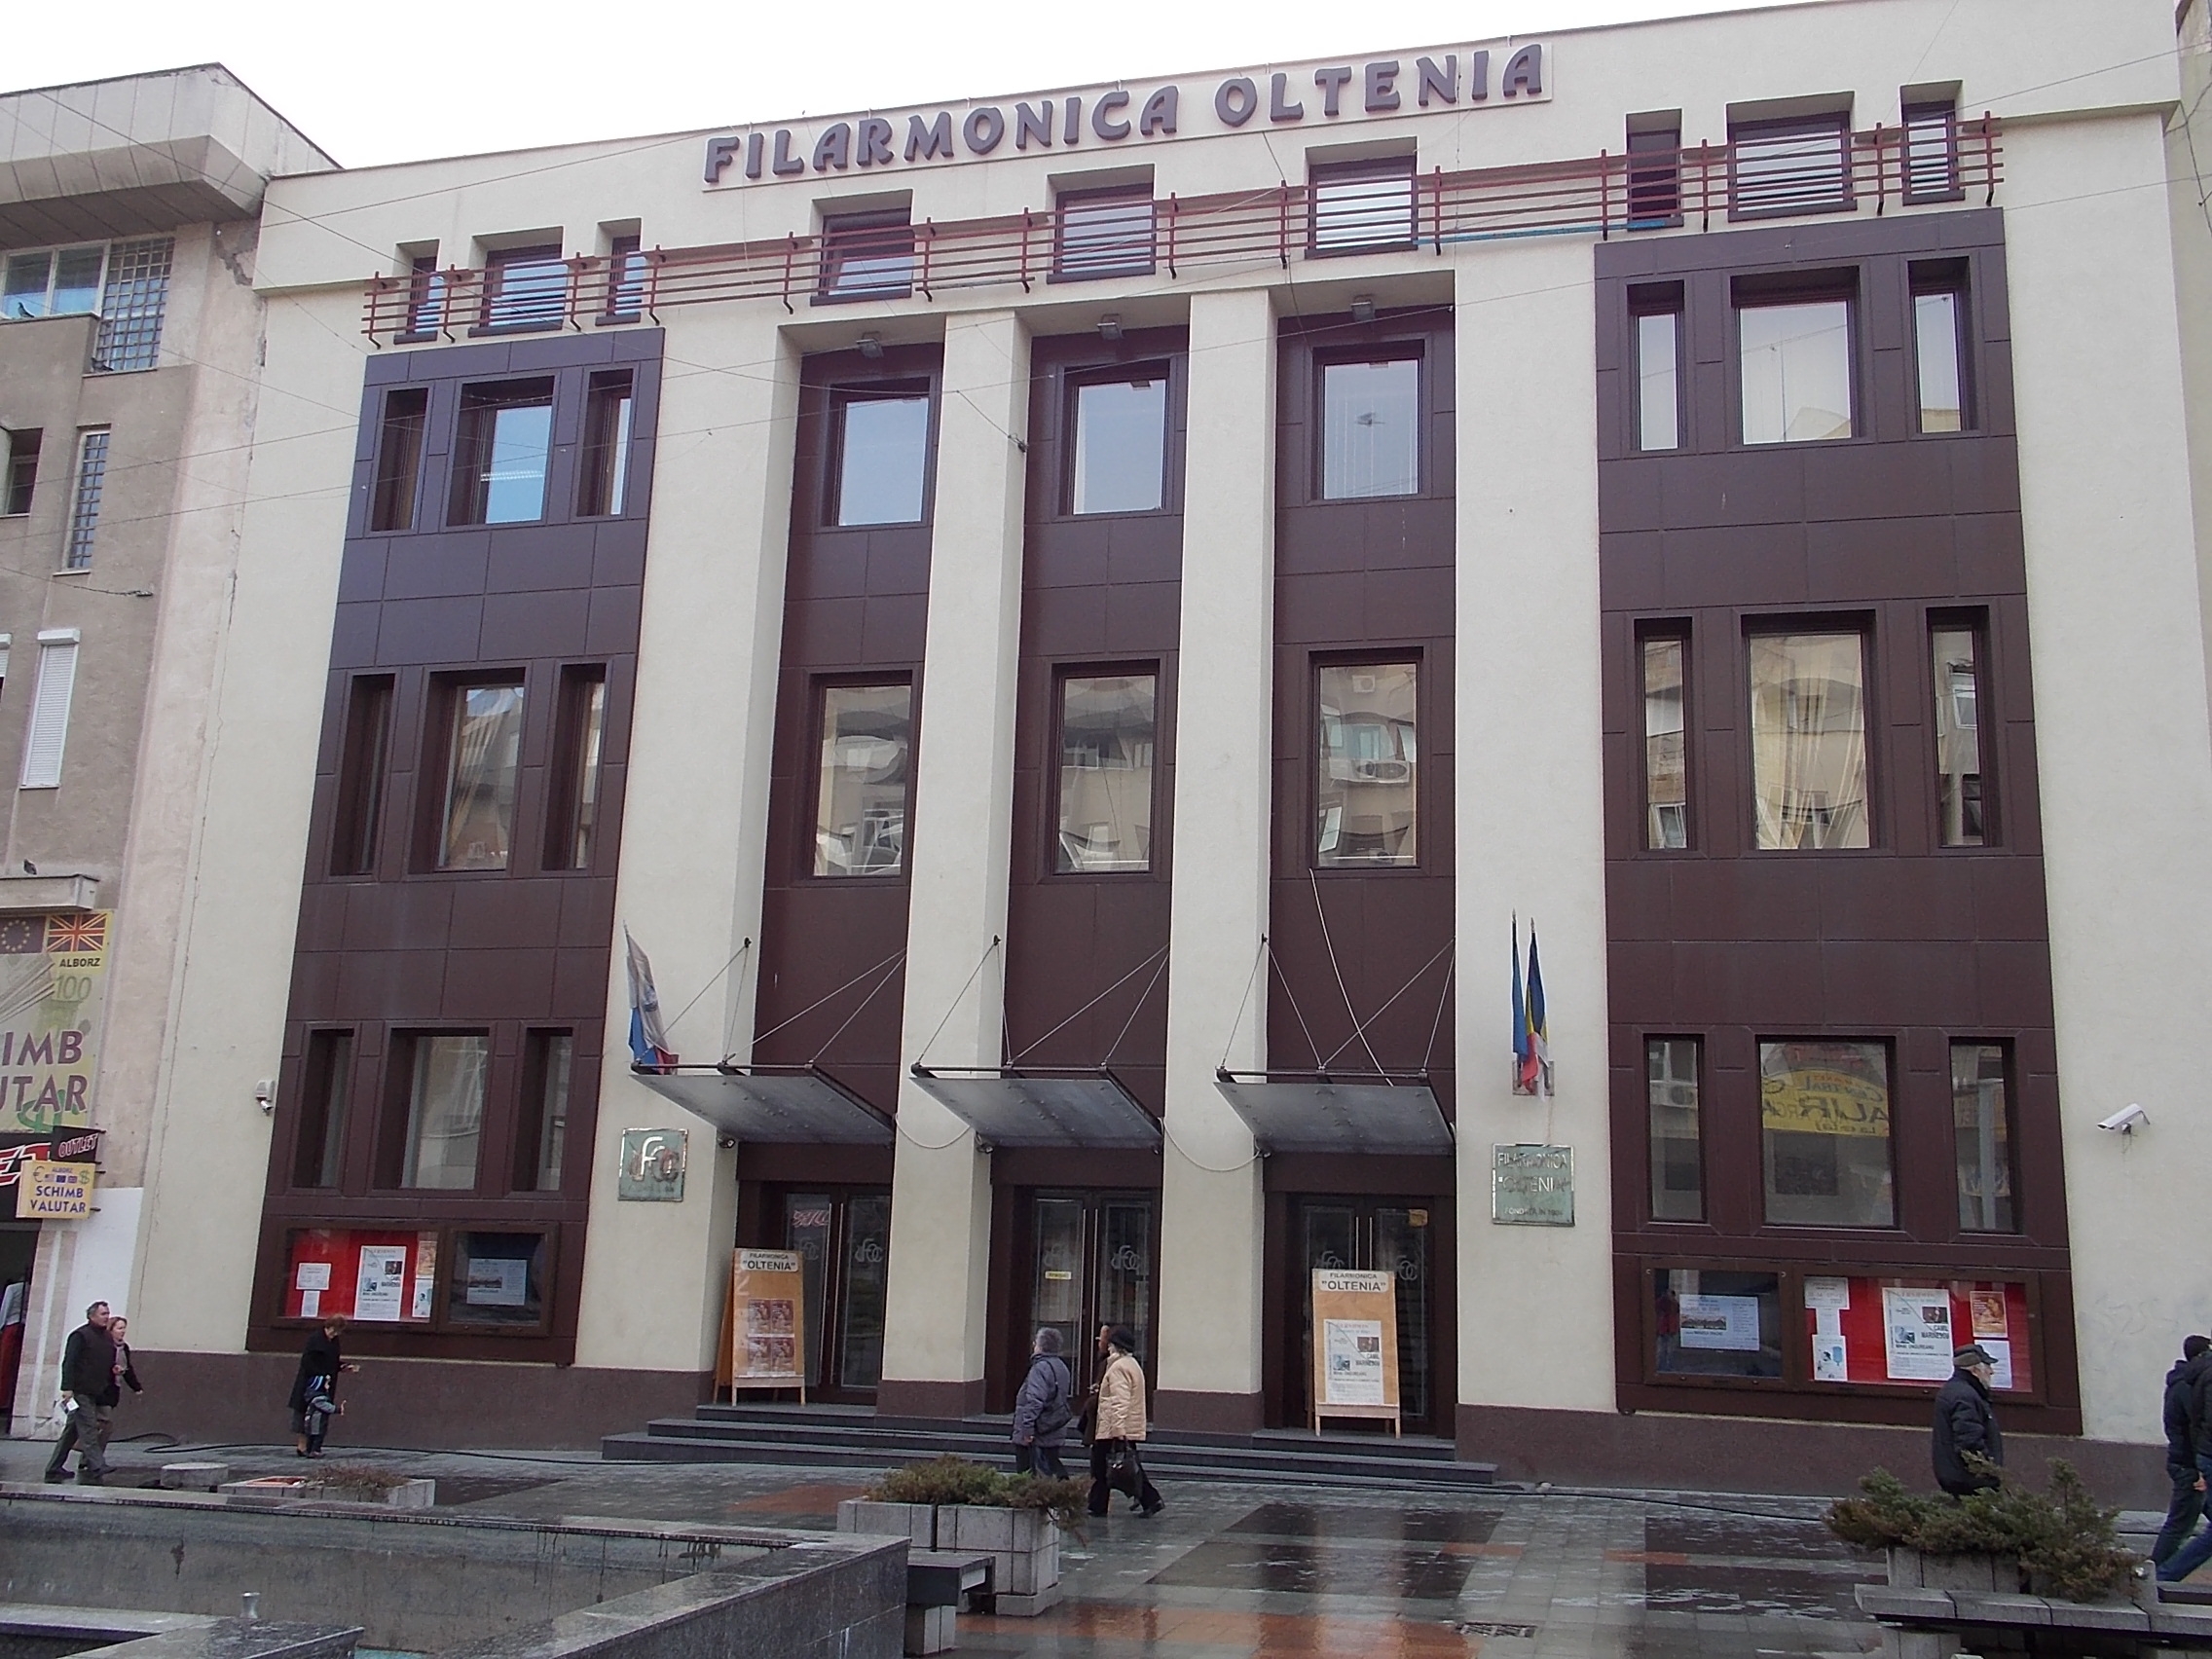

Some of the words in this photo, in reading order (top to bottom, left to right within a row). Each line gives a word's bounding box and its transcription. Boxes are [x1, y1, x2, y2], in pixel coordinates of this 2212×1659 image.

[704, 85, 1179, 183] FILARMONICA
[1215, 43, 1542, 127] OLTENIA
[59, 957, 100, 968] ALBORZ
[2, 1030, 83, 1066] IMB
[58, 1132, 98, 1158] OUTLET
[36, 1185, 84, 1198] SCHIMB
[30, 1198, 86, 1213] VALUTAR
[1330, 1272, 1377, 1280] FILARMONICA
